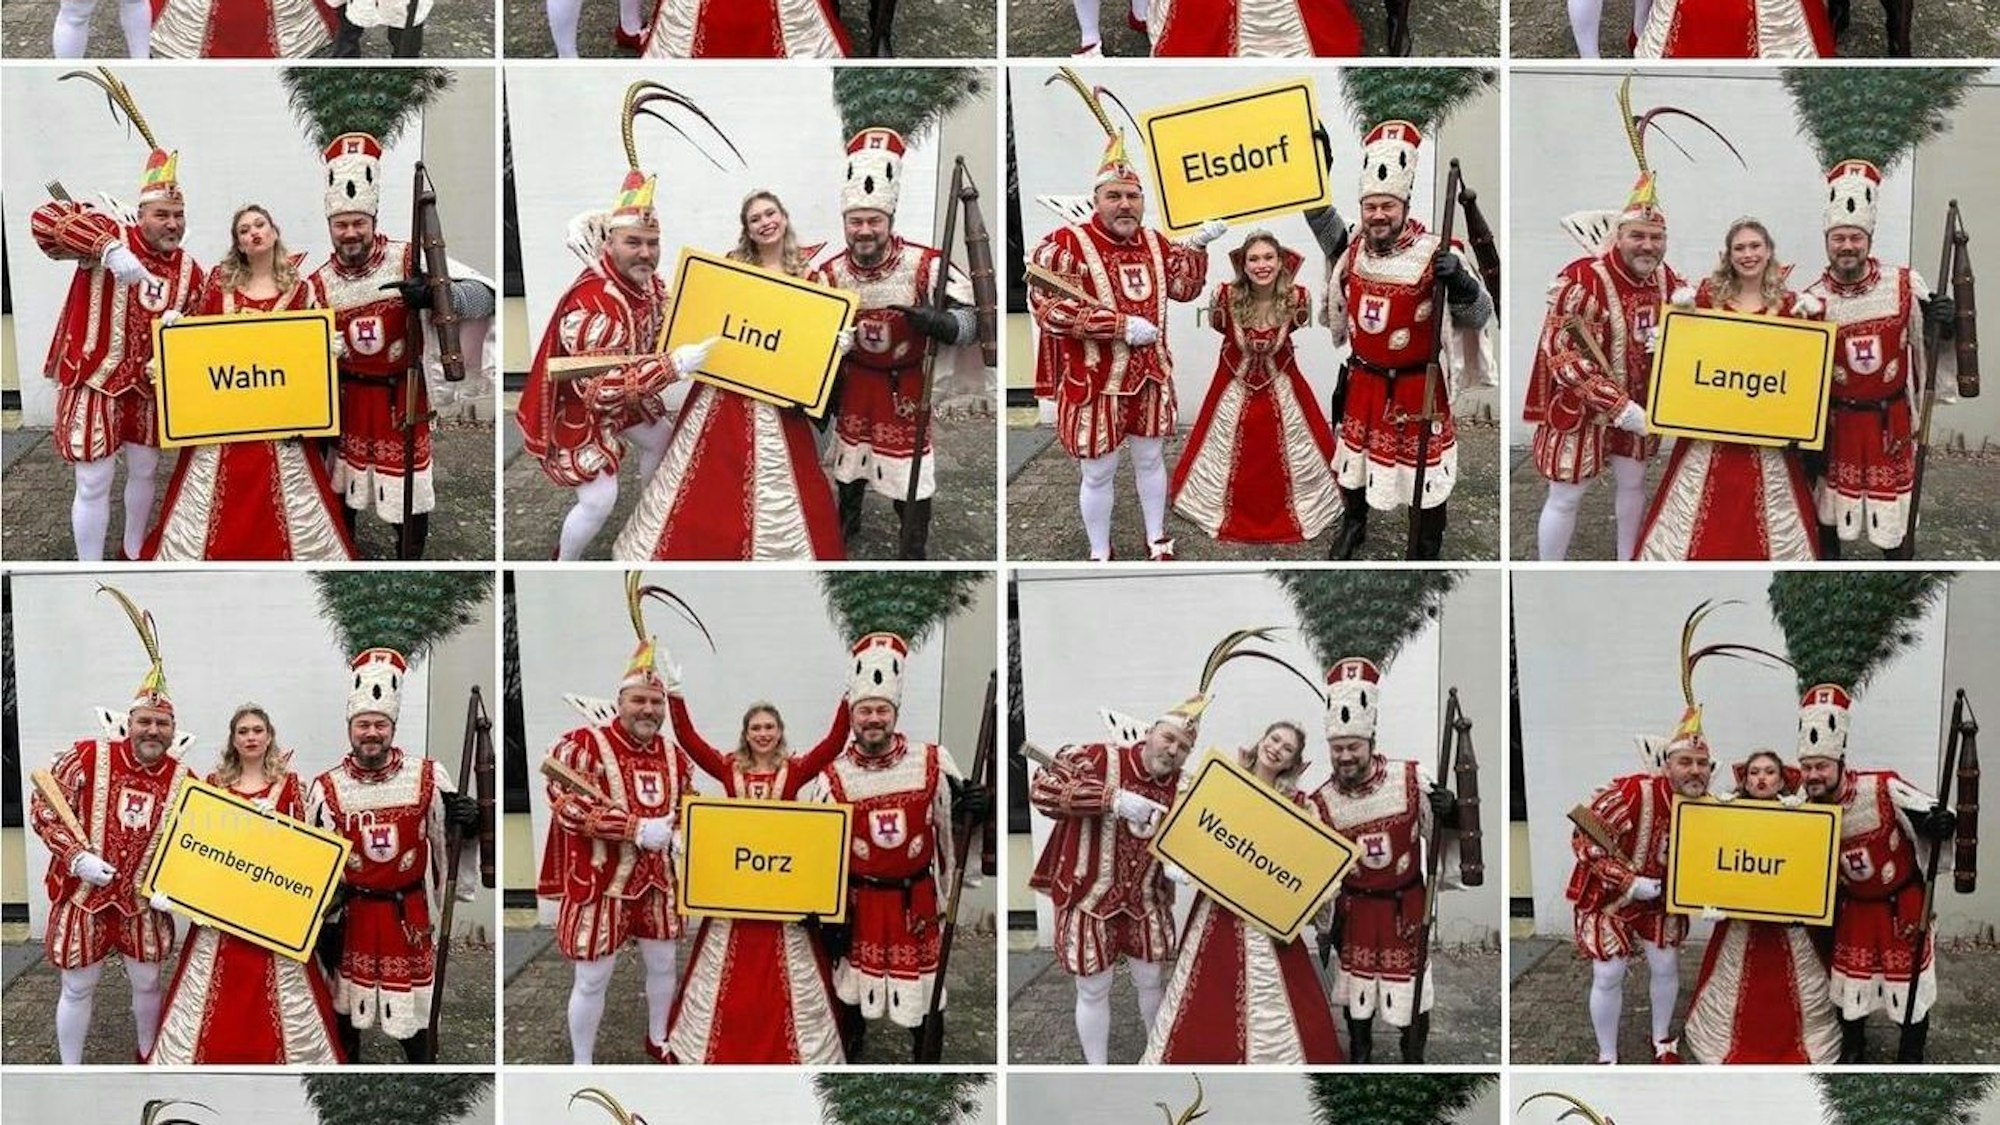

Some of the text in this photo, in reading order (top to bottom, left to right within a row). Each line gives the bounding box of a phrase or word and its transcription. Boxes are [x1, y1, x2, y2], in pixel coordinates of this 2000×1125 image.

[1182, 134, 1289, 183] Elsdorf
[722, 314, 781, 352] Lind
[208, 364, 286, 391] Wahn
[1694, 360, 1786, 398] Langel
[179, 833, 314, 900] Gremberghoven
[735, 847, 792, 873] Porz
[1198, 808, 1303, 893] Westhoven
[1717, 847, 1786, 875] Libur
